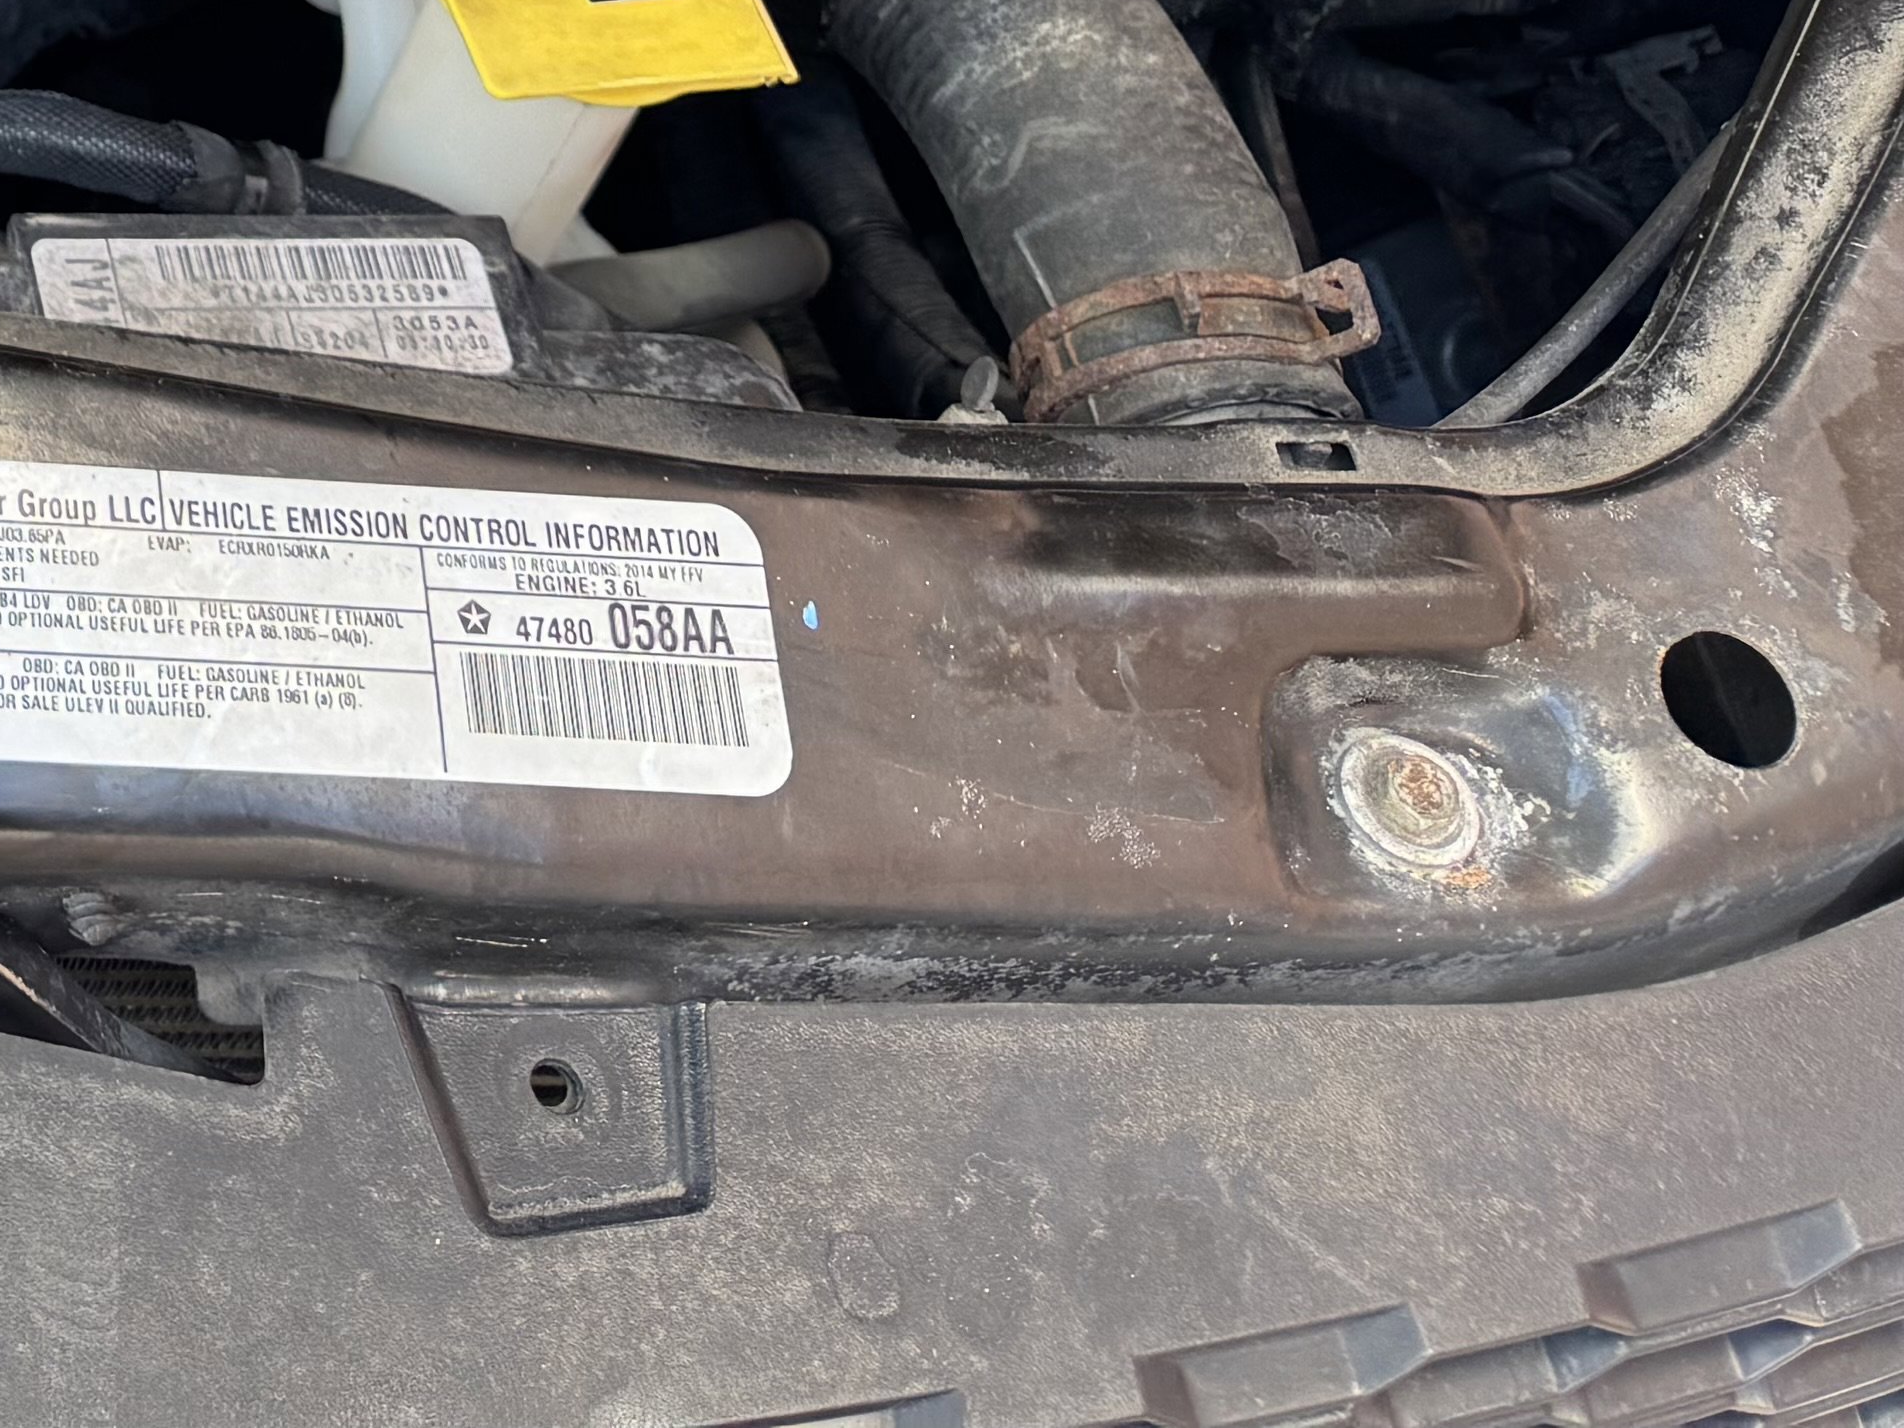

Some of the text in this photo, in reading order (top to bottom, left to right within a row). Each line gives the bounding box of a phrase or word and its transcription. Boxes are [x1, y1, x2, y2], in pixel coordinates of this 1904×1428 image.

[17, 488, 96, 525] Group
[108, 494, 157, 524] LLC
[169, 498, 276, 531] VEHICLE
[287, 506, 408, 540] EMISSION
[419, 514, 536, 547] CONTROL
[545, 521, 720, 557] INFORMATION
[40, 548, 99, 567] NEEDED
[148, 536, 191, 554] EVAP:
[2, 567, 24, 582] SFI
[437, 552, 704, 583] CONFORMS TO REGULATIONS: 2014 MY FFV
[515, 574, 646, 597] ENGINE: 3.6L
[0, 593, 17, 608] B4
[23, 594, 50, 610] LDV
[66, 595, 102, 613] OBD:
[107, 598, 127, 614] CA
[132, 599, 163, 616] OBD
[168, 600, 177, 616] II
[199, 602, 242, 620] FUEL:
[247, 604, 319, 624] GASOLINE
[335, 609, 404, 629] ETHANOL
[8, 611, 84, 630] OPTIONAL
[89, 614, 148, 633] USEFUL
[154, 619, 184, 635] LIFE
[191, 621, 221, 638] PER
[226, 622, 255, 640] EPA
[516, 602, 735, 656] 47480 058AA
[22, 657, 58, 674] OBD:
[64, 660, 84, 676] CA
[89, 661, 120, 677] OBD
[126, 663, 135, 678] II
[157, 664, 201, 681] FUEL:
[206, 666, 279, 685] GASOLINE
[296, 671, 366, 690] ETHANOL
[10, 675, 86, 694] OPTIONAL
[92, 679, 152, 698] USEFUL
[158, 683, 189, 700] LIFE
[196, 684, 224, 701] PER
[230, 686, 269, 703] CARB
[277, 689, 308, 705] 1961
[314, 691, 334, 709] (a)
[22, 694, 59, 712] SALE
[65, 697, 104, 714] ULEV
[109, 699, 119, 715] II
[125, 699, 211, 719] QUALIFIED.
